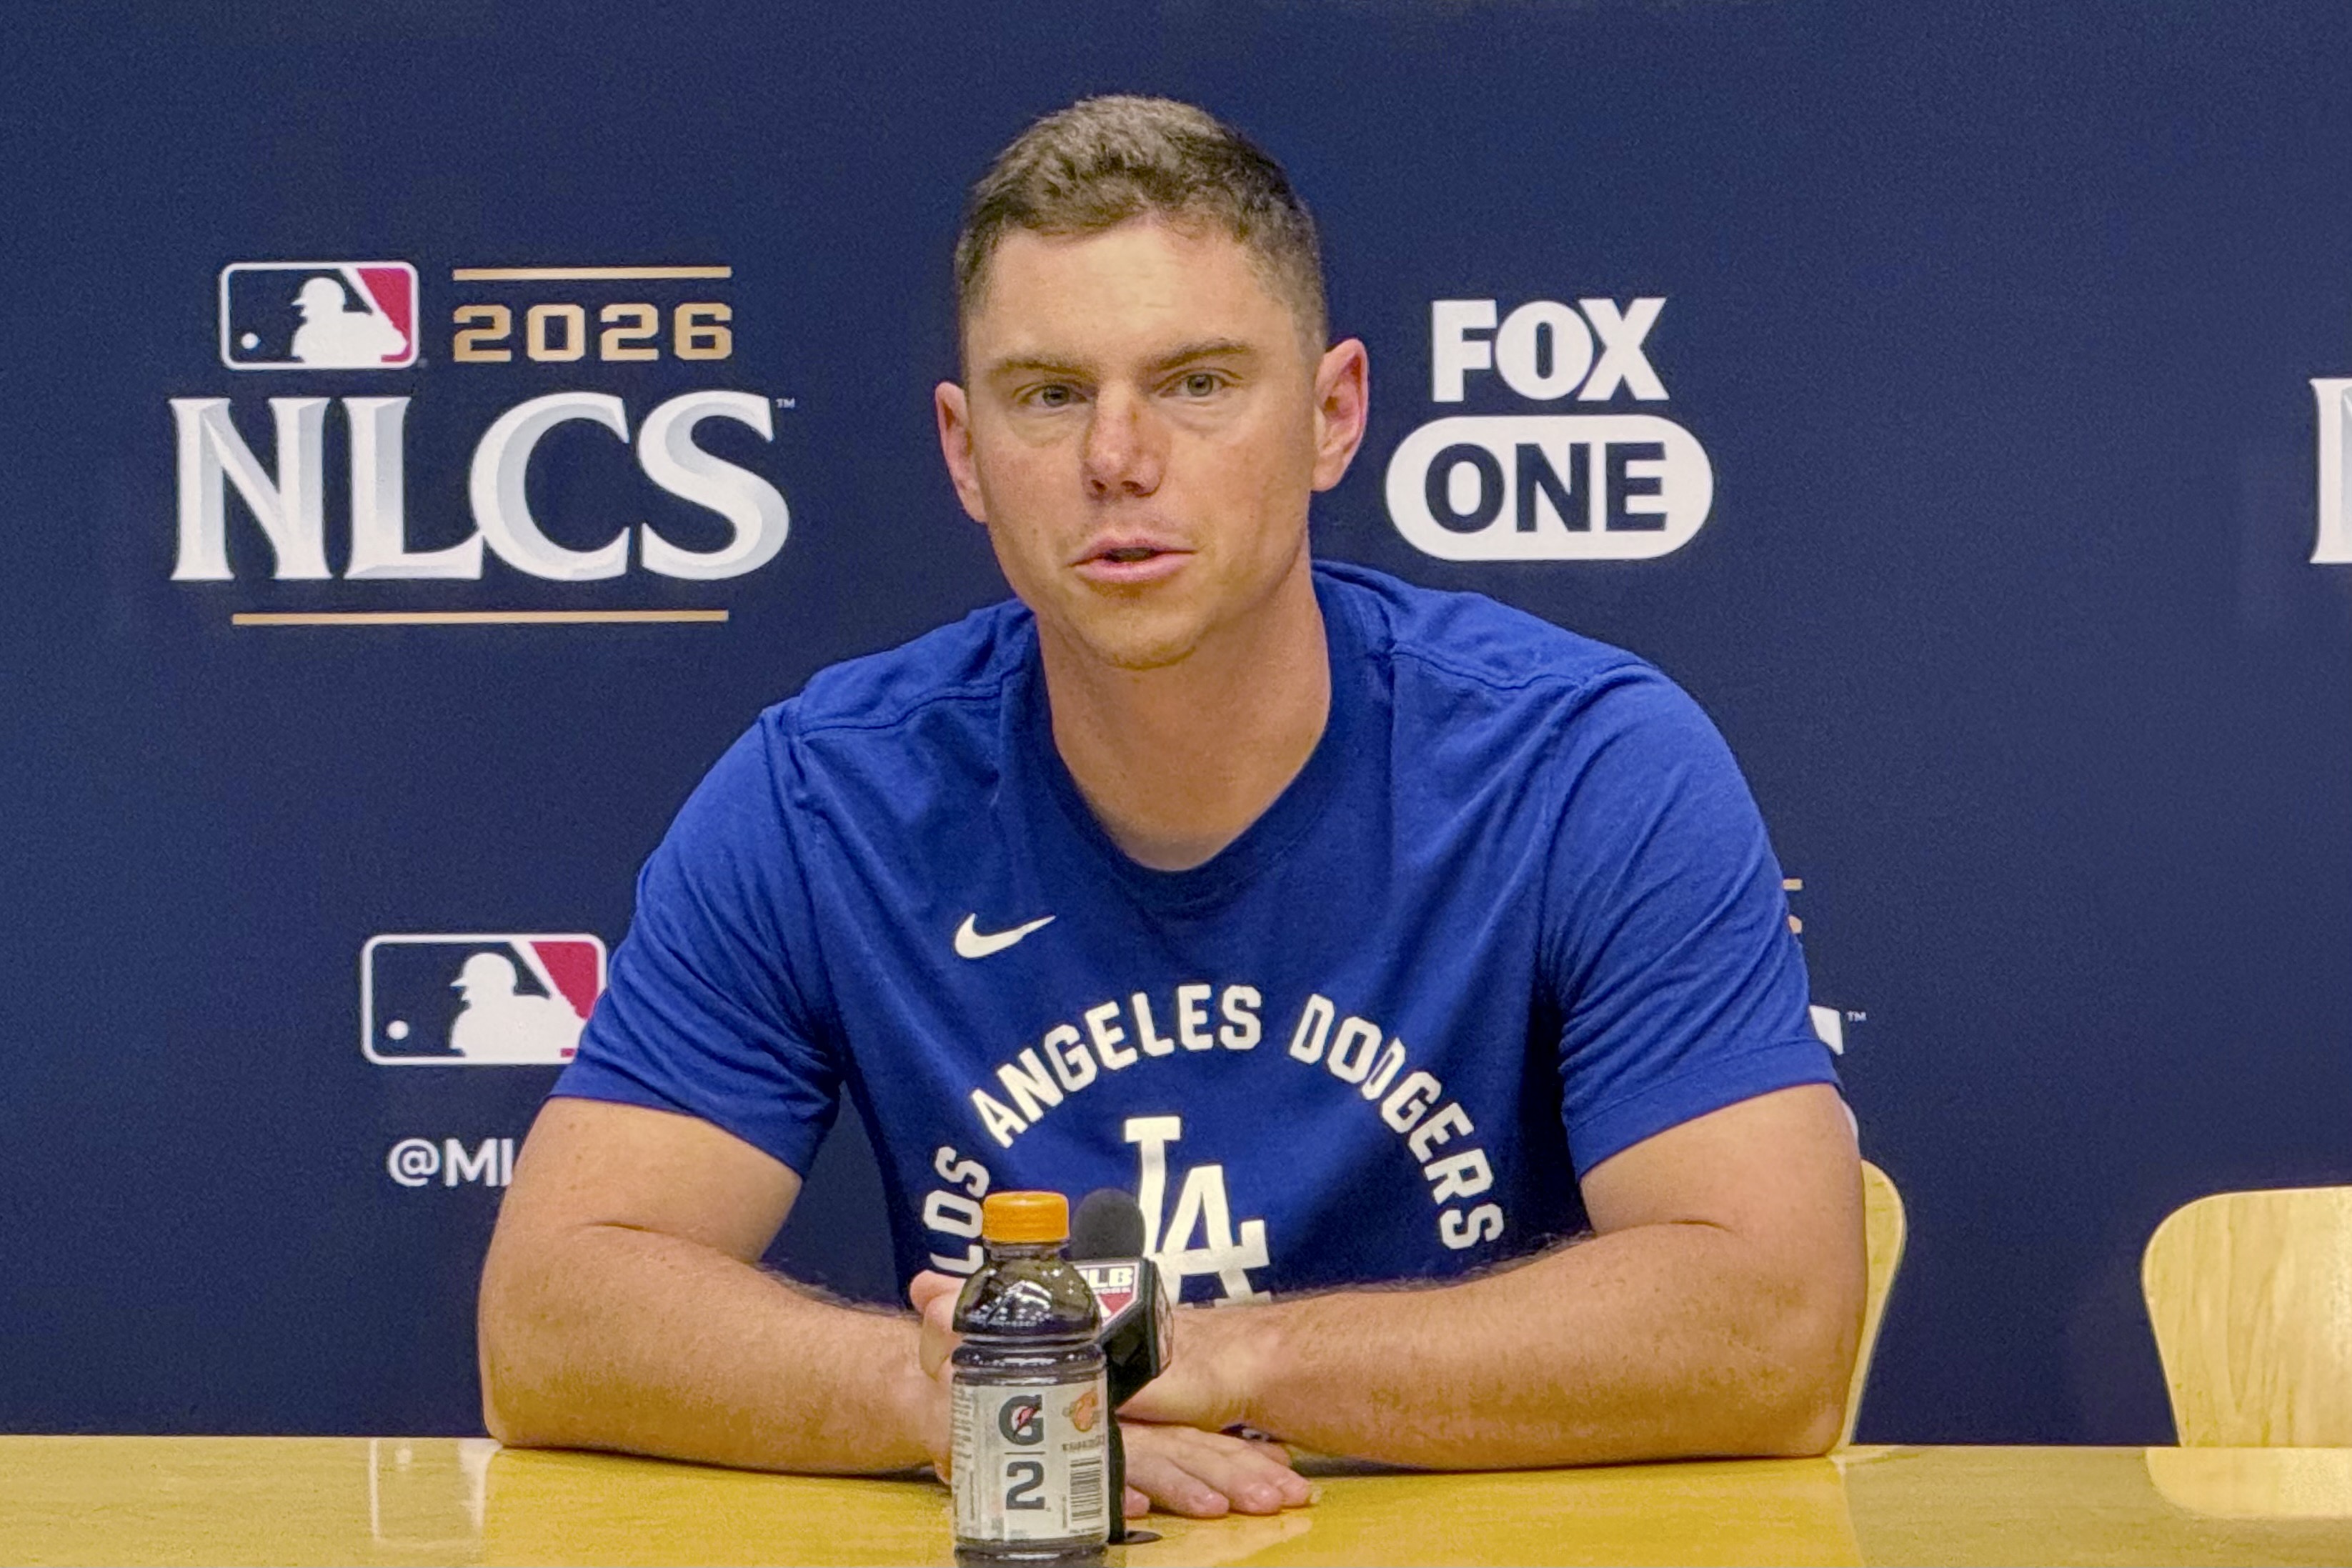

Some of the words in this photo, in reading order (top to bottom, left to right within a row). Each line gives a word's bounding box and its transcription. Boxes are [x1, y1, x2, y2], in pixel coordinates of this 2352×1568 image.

[454, 303, 732, 361] 2026
[1432, 297, 1670, 402] FOX
[169, 391, 790, 581] NLCS
[1425, 441, 1668, 534] ONE
[924, 1147, 990, 1274] LOS
[970, 984, 1262, 1148] ANGELES
[1290, 994, 1505, 1250] DODGERS
[1125, 1116, 1271, 1310] LA
[1079, 1267, 1133, 1288] LB
[999, 1394, 1044, 1446] G
[1006, 1461, 1045, 1510] 2
